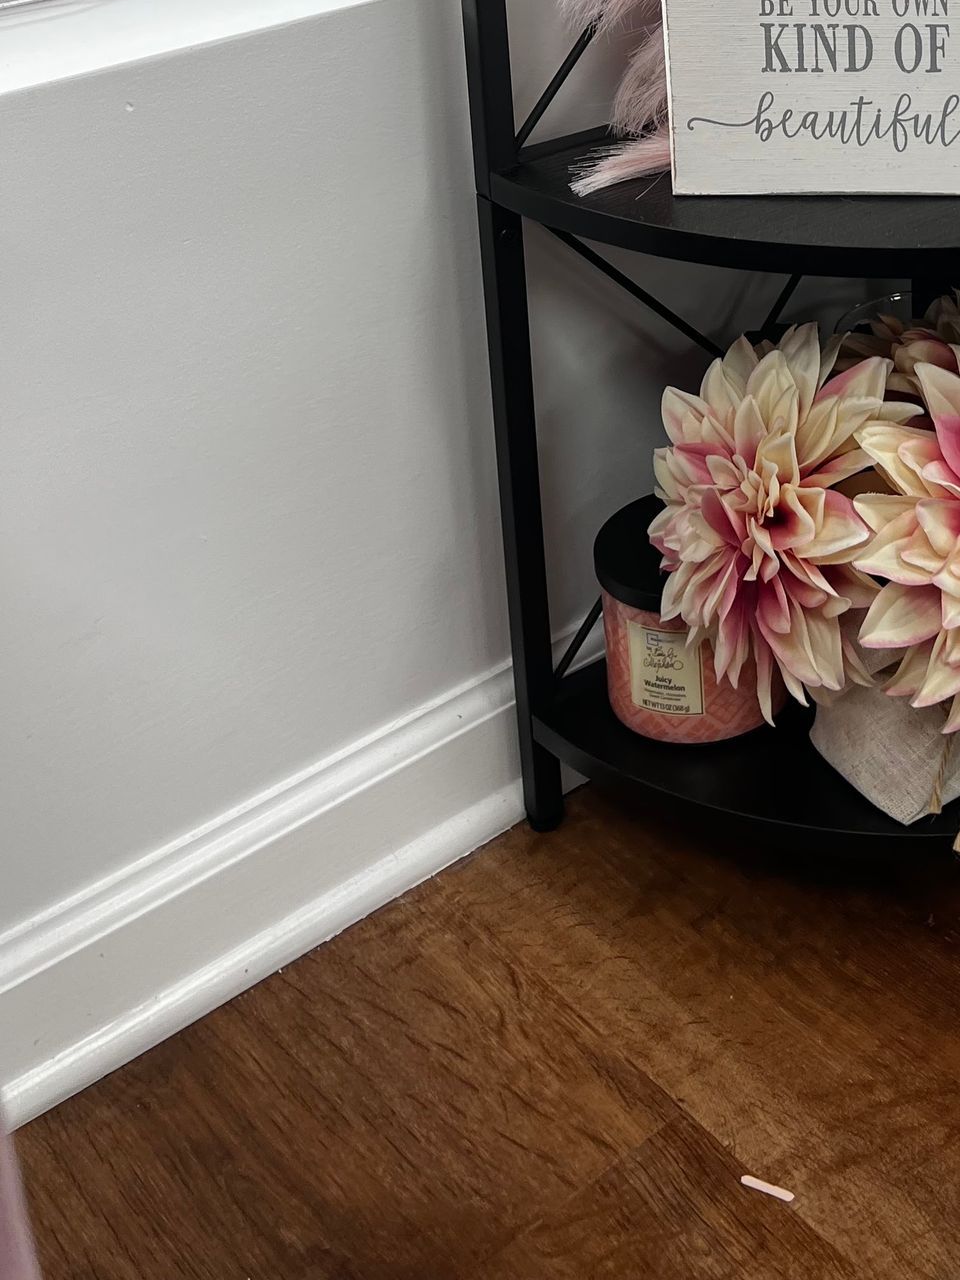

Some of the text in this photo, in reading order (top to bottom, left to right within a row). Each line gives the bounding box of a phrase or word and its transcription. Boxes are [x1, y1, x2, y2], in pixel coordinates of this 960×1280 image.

[759, 22, 950, 74] KIND OF
[644, 679, 685, 691] Watermelon
[655, 675, 672, 684] Juicy
